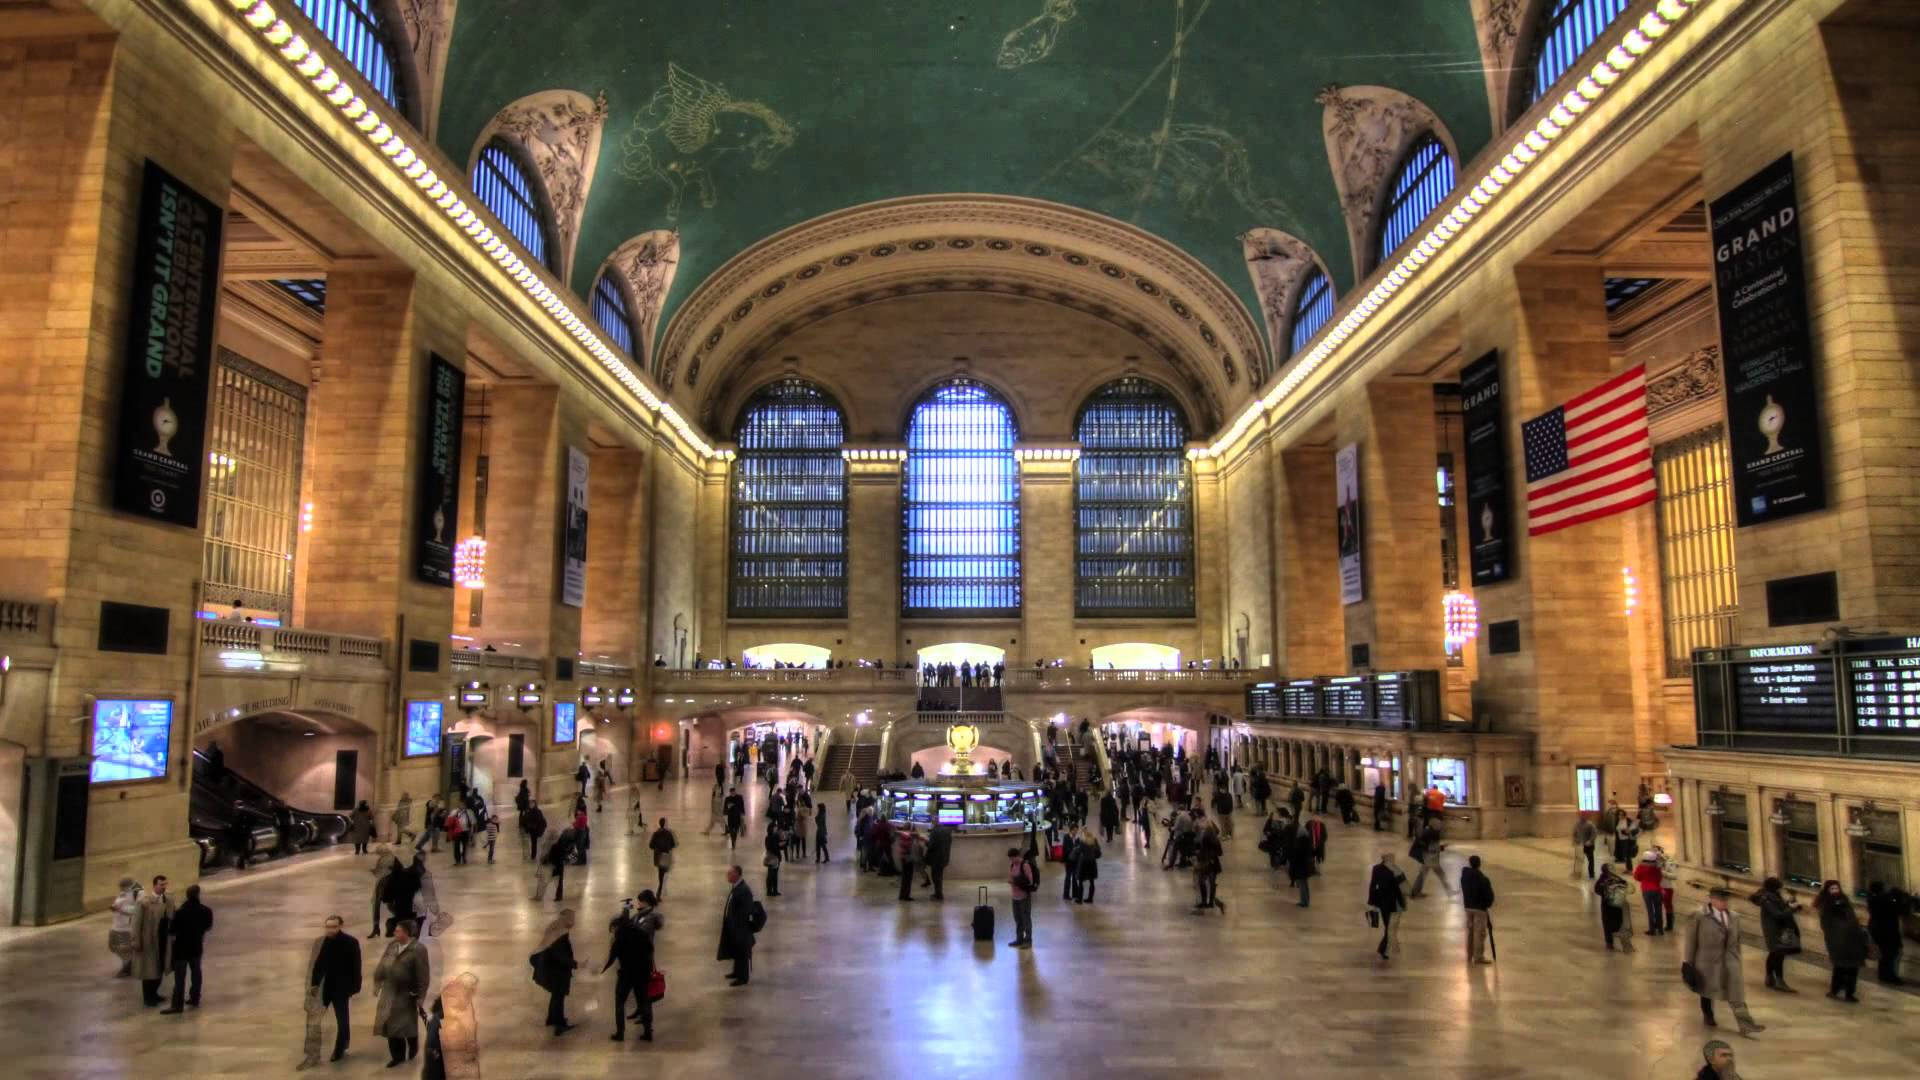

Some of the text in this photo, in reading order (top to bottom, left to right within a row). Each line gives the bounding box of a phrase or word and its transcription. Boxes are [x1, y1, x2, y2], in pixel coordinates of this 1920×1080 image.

[1717, 207, 1795, 263] GRAND
[145, 182, 178, 379] ISN'T IT GRAND
[165, 193, 191, 368] CELEBRATION
[1741, 267, 1784, 295] Centennial
[178, 228, 206, 377] CENTENNIAL
[1731, 282, 1778, 309] Celebration
[1463, 382, 1498, 410] GRAND
[132, 448, 188, 470] GRAND CENTRAL
[1747, 448, 1804, 469] GRAND CENTRAL
[1750, 645, 1812, 657] INFORMATION
[1851, 660, 1871, 668] TIME
[1876, 659, 1895, 667] TRK
